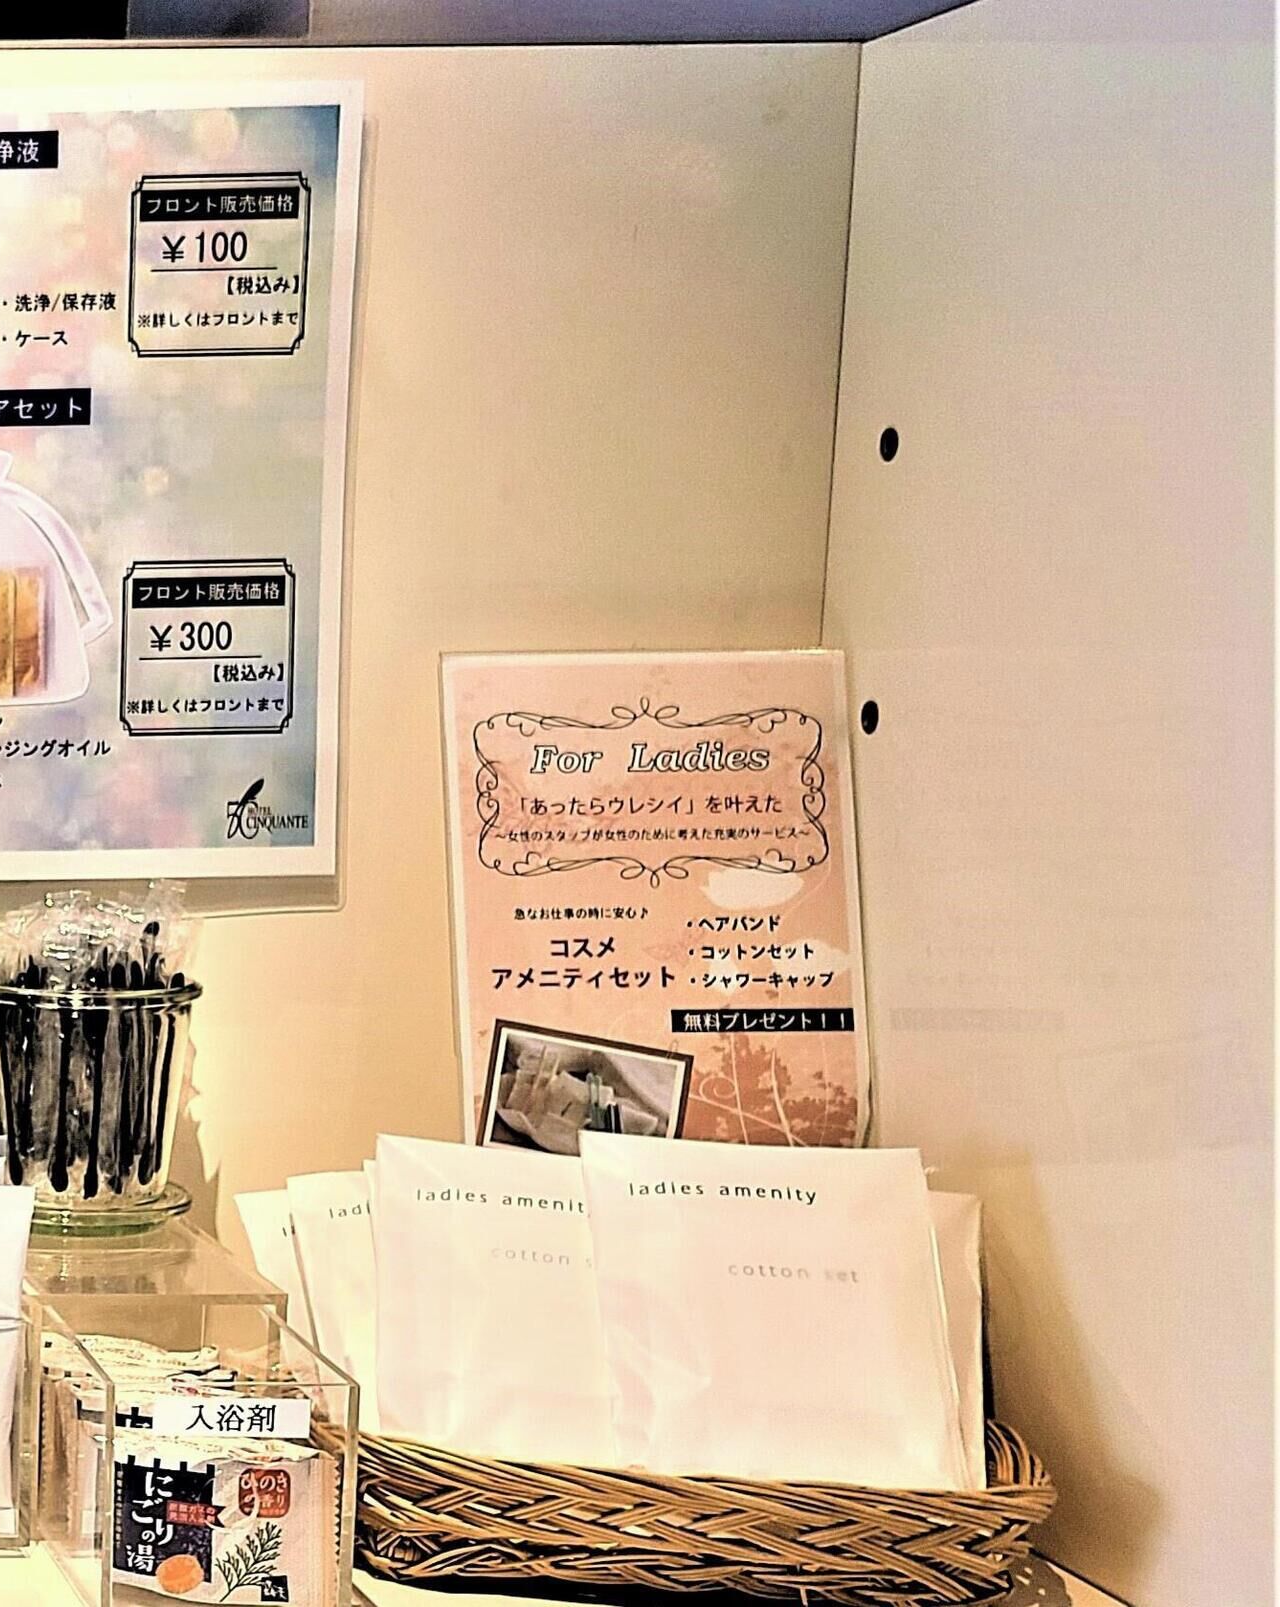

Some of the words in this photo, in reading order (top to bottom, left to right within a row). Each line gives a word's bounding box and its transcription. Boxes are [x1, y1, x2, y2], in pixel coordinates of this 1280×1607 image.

[147, 194, 295, 216] フロント販売価格
[223, 275, 302, 297] 【税込み】
[14, 292, 117, 313] 洗浄/保存液
[15, 329, 69, 348] ケース
[138, 582, 281, 603] フロント販売価格
[211, 664, 288, 684] 【税込み】
[530, 744, 603, 774] For
[627, 740, 770, 773] Ladies
[245, 814, 309, 834] CINQUANTE
[698, 915, 781, 933] ヘアバンド
[549, 936, 617, 960] コスメ
[701, 943, 815, 961] コットンセット
[491, 966, 676, 990] アメニティセット
[701, 970, 835, 989] シャワーキャップ
[417, 1187, 488, 1204] ladies
[502, 1194, 592, 1217] amenit
[629, 1180, 704, 1197] ladies
[719, 1185, 817, 1206] amenity
[185, 1404, 278, 1433] 入浴剤
